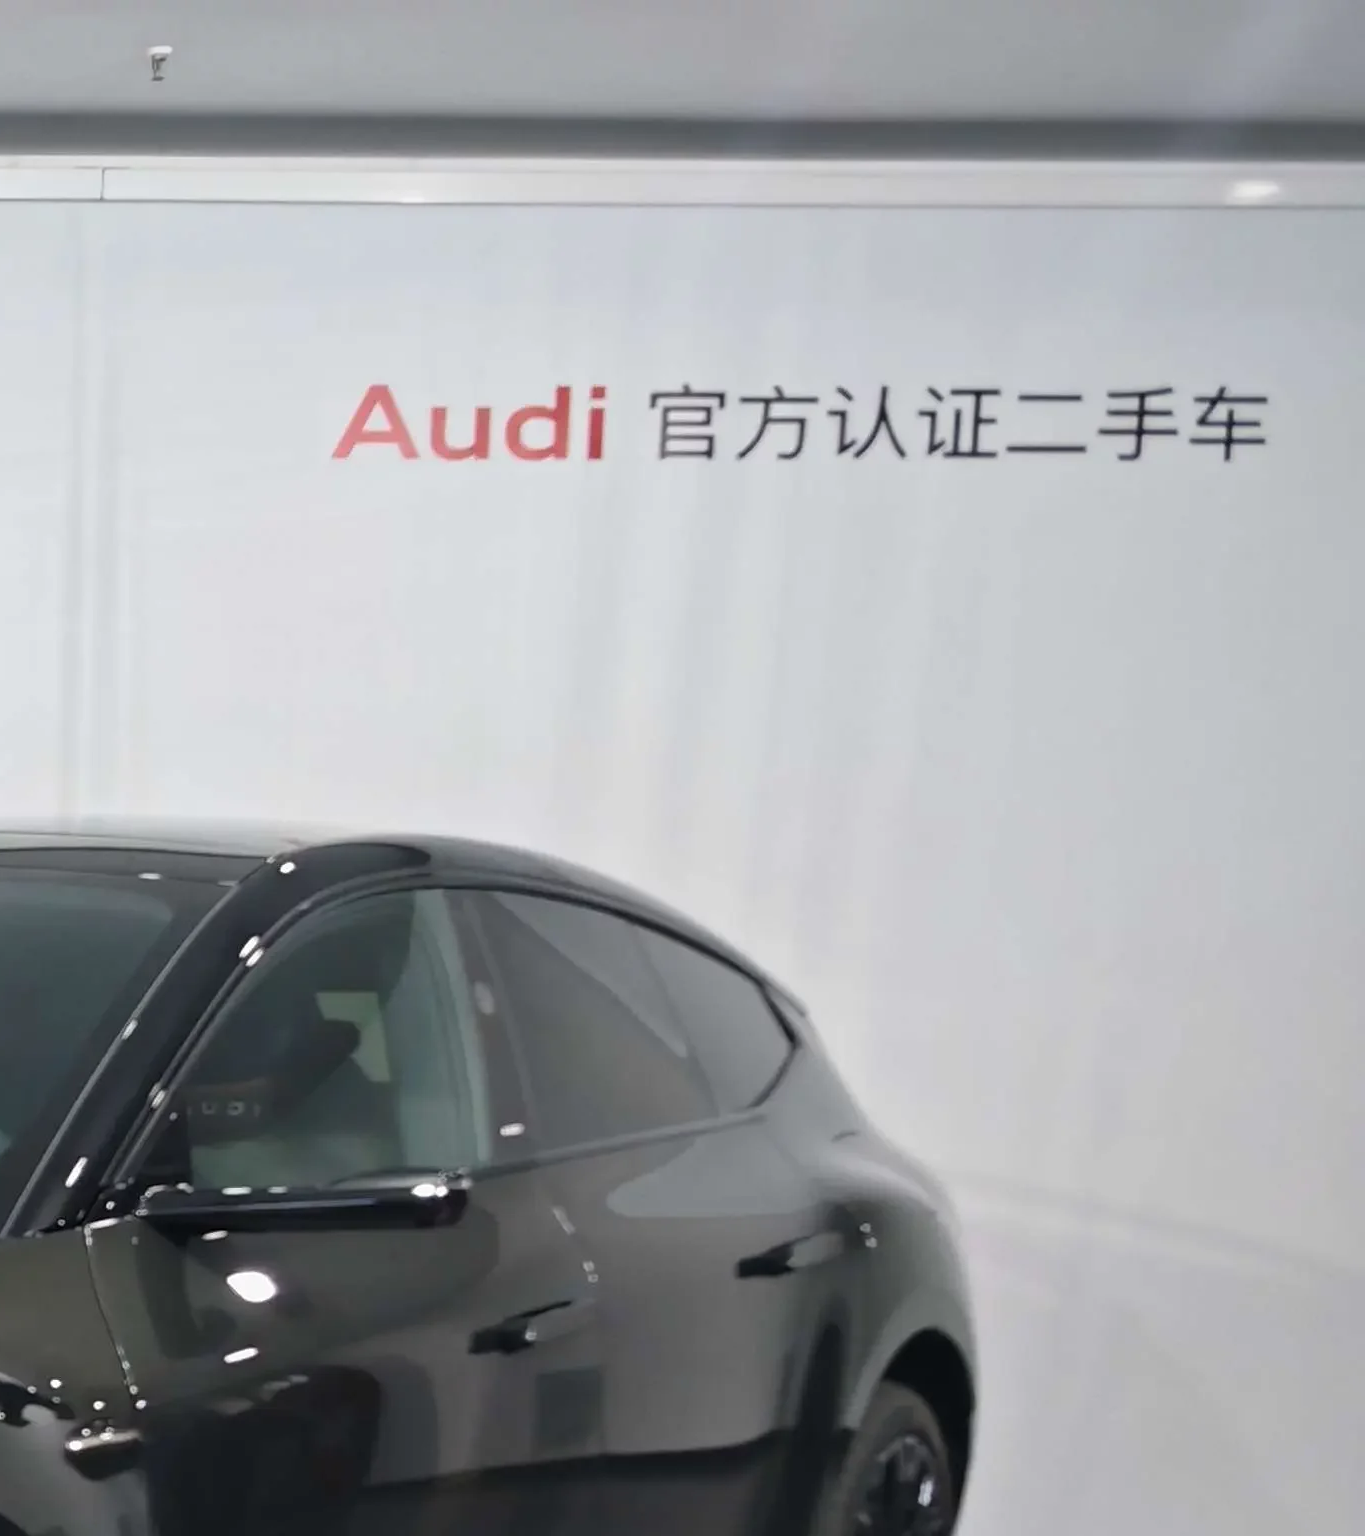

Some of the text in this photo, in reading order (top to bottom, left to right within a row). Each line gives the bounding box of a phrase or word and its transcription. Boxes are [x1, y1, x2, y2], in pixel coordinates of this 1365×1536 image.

[332, 384, 1269, 462] Audi 官方认证二手车
